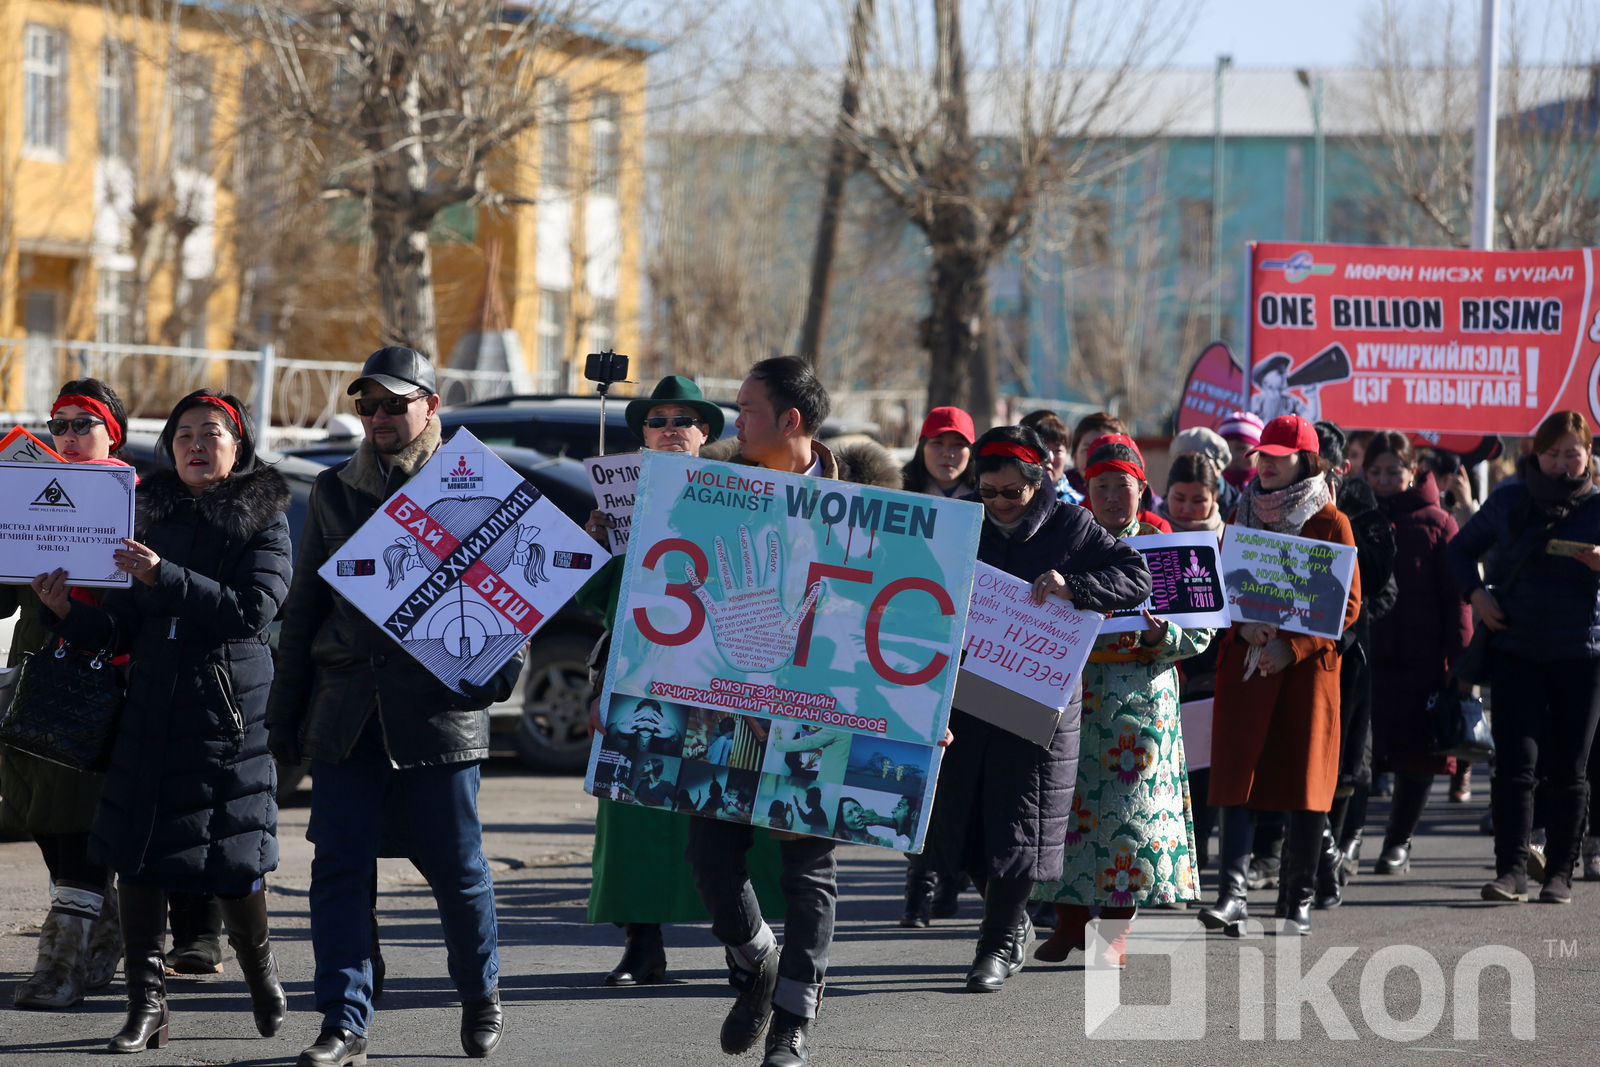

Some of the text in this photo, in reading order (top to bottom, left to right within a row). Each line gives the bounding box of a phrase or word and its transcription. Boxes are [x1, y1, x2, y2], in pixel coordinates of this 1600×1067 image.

[1344, 263, 1413, 282] МӨРӨН
[1418, 265, 1484, 283] НИСЭХ
[1259, 293, 1562, 334] ONE BILLION RISING
[1353, 378, 1391, 406] ЦЭГ
[447, 482, 476, 490] MONGOLIA
[682, 485, 774, 513] AGAINST
[685, 469, 938, 539] VIOLENCE WOMEN
[33, 523, 75, 533] АЙМГИЙН
[77, 526, 116, 535] ИРГЭНИЙ
[394, 499, 444, 547] БАЙ
[1295, 543, 1342, 560] ЧАДДАГ
[1147, 551, 1170, 611] МОНГОЛ
[477, 574, 531, 625] БИШ
[1194, 592, 1215, 608] 2018
[768, 701, 820, 721] ТАСЛАН
[821, 710, 887, 732] ЗОГСООЁ
